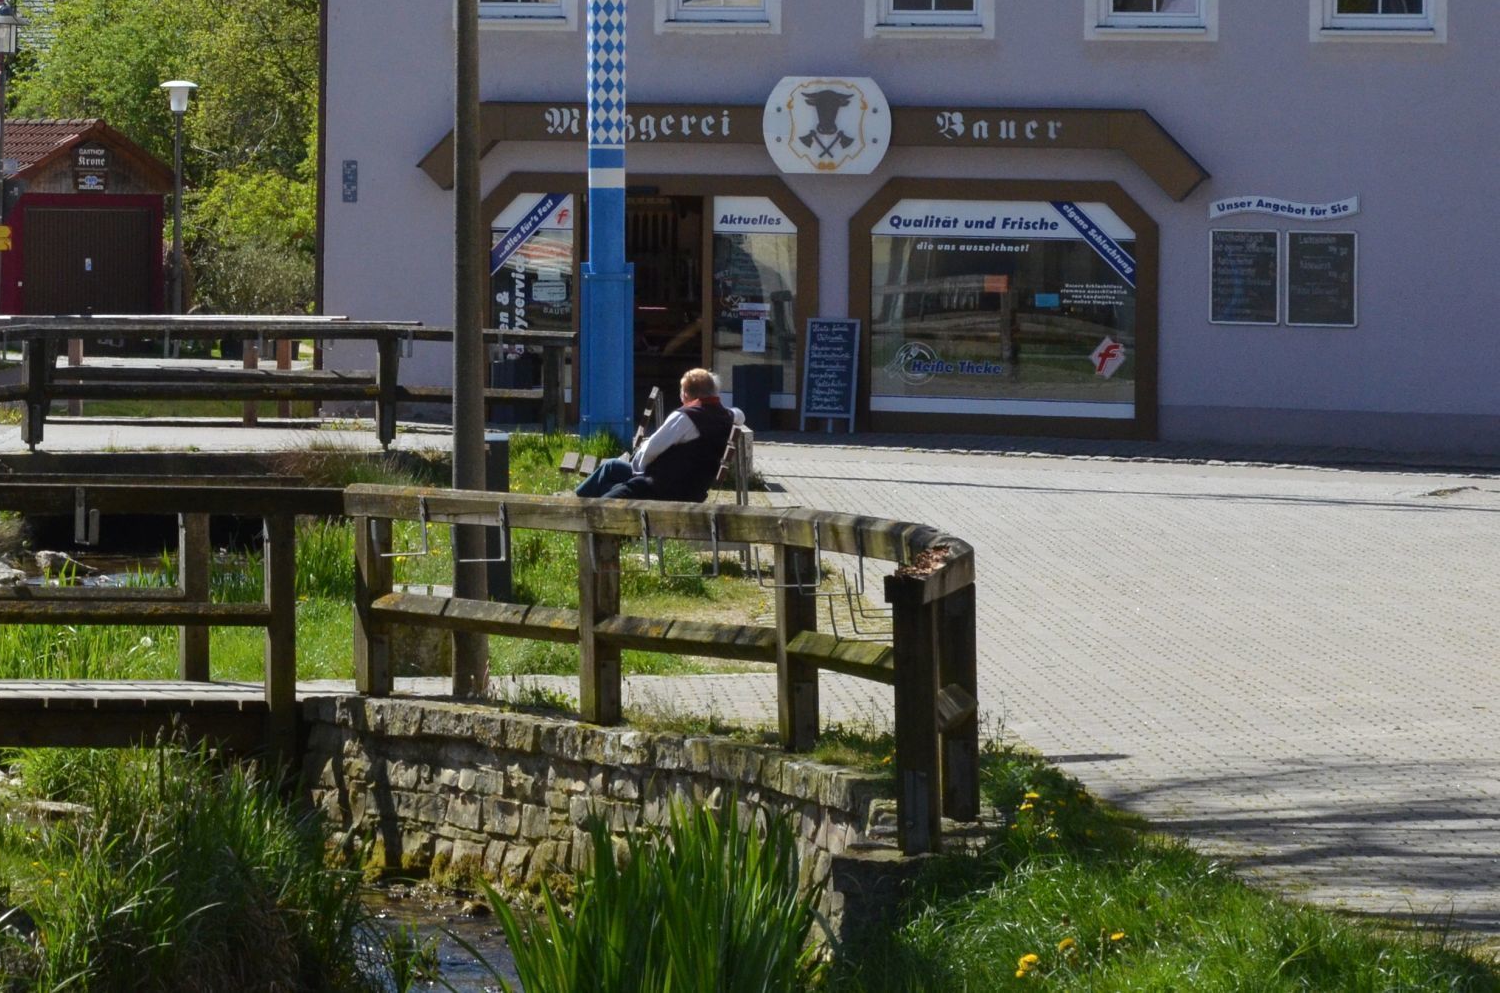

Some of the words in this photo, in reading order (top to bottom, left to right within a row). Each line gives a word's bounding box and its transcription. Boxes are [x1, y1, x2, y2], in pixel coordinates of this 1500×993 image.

[545, 108, 731, 141] Mzgerei
[936, 110, 1063, 142] Bauer
[78, 156, 106, 166] Krone
[537, 199, 554, 221] Fest
[1217, 199, 1252, 212] Unser
[1256, 199, 1306, 216] Angebot
[1310, 206, 1327, 216] für
[1331, 204, 1349, 214] Sie
[719, 214, 782, 226] Aktuelles
[889, 215, 959, 229] Qualität
[964, 216, 996, 230] und
[1001, 217, 1059, 231] Frische
[916, 241, 934, 251] die
[937, 243, 956, 251] uns
[959, 242, 1030, 253] auszeichnet!
[1062, 203, 1089, 230] eigene
[1087, 227, 1134, 275] Schlachtung
[911, 361, 953, 374] Heiße
[958, 361, 1001, 375] Theke
